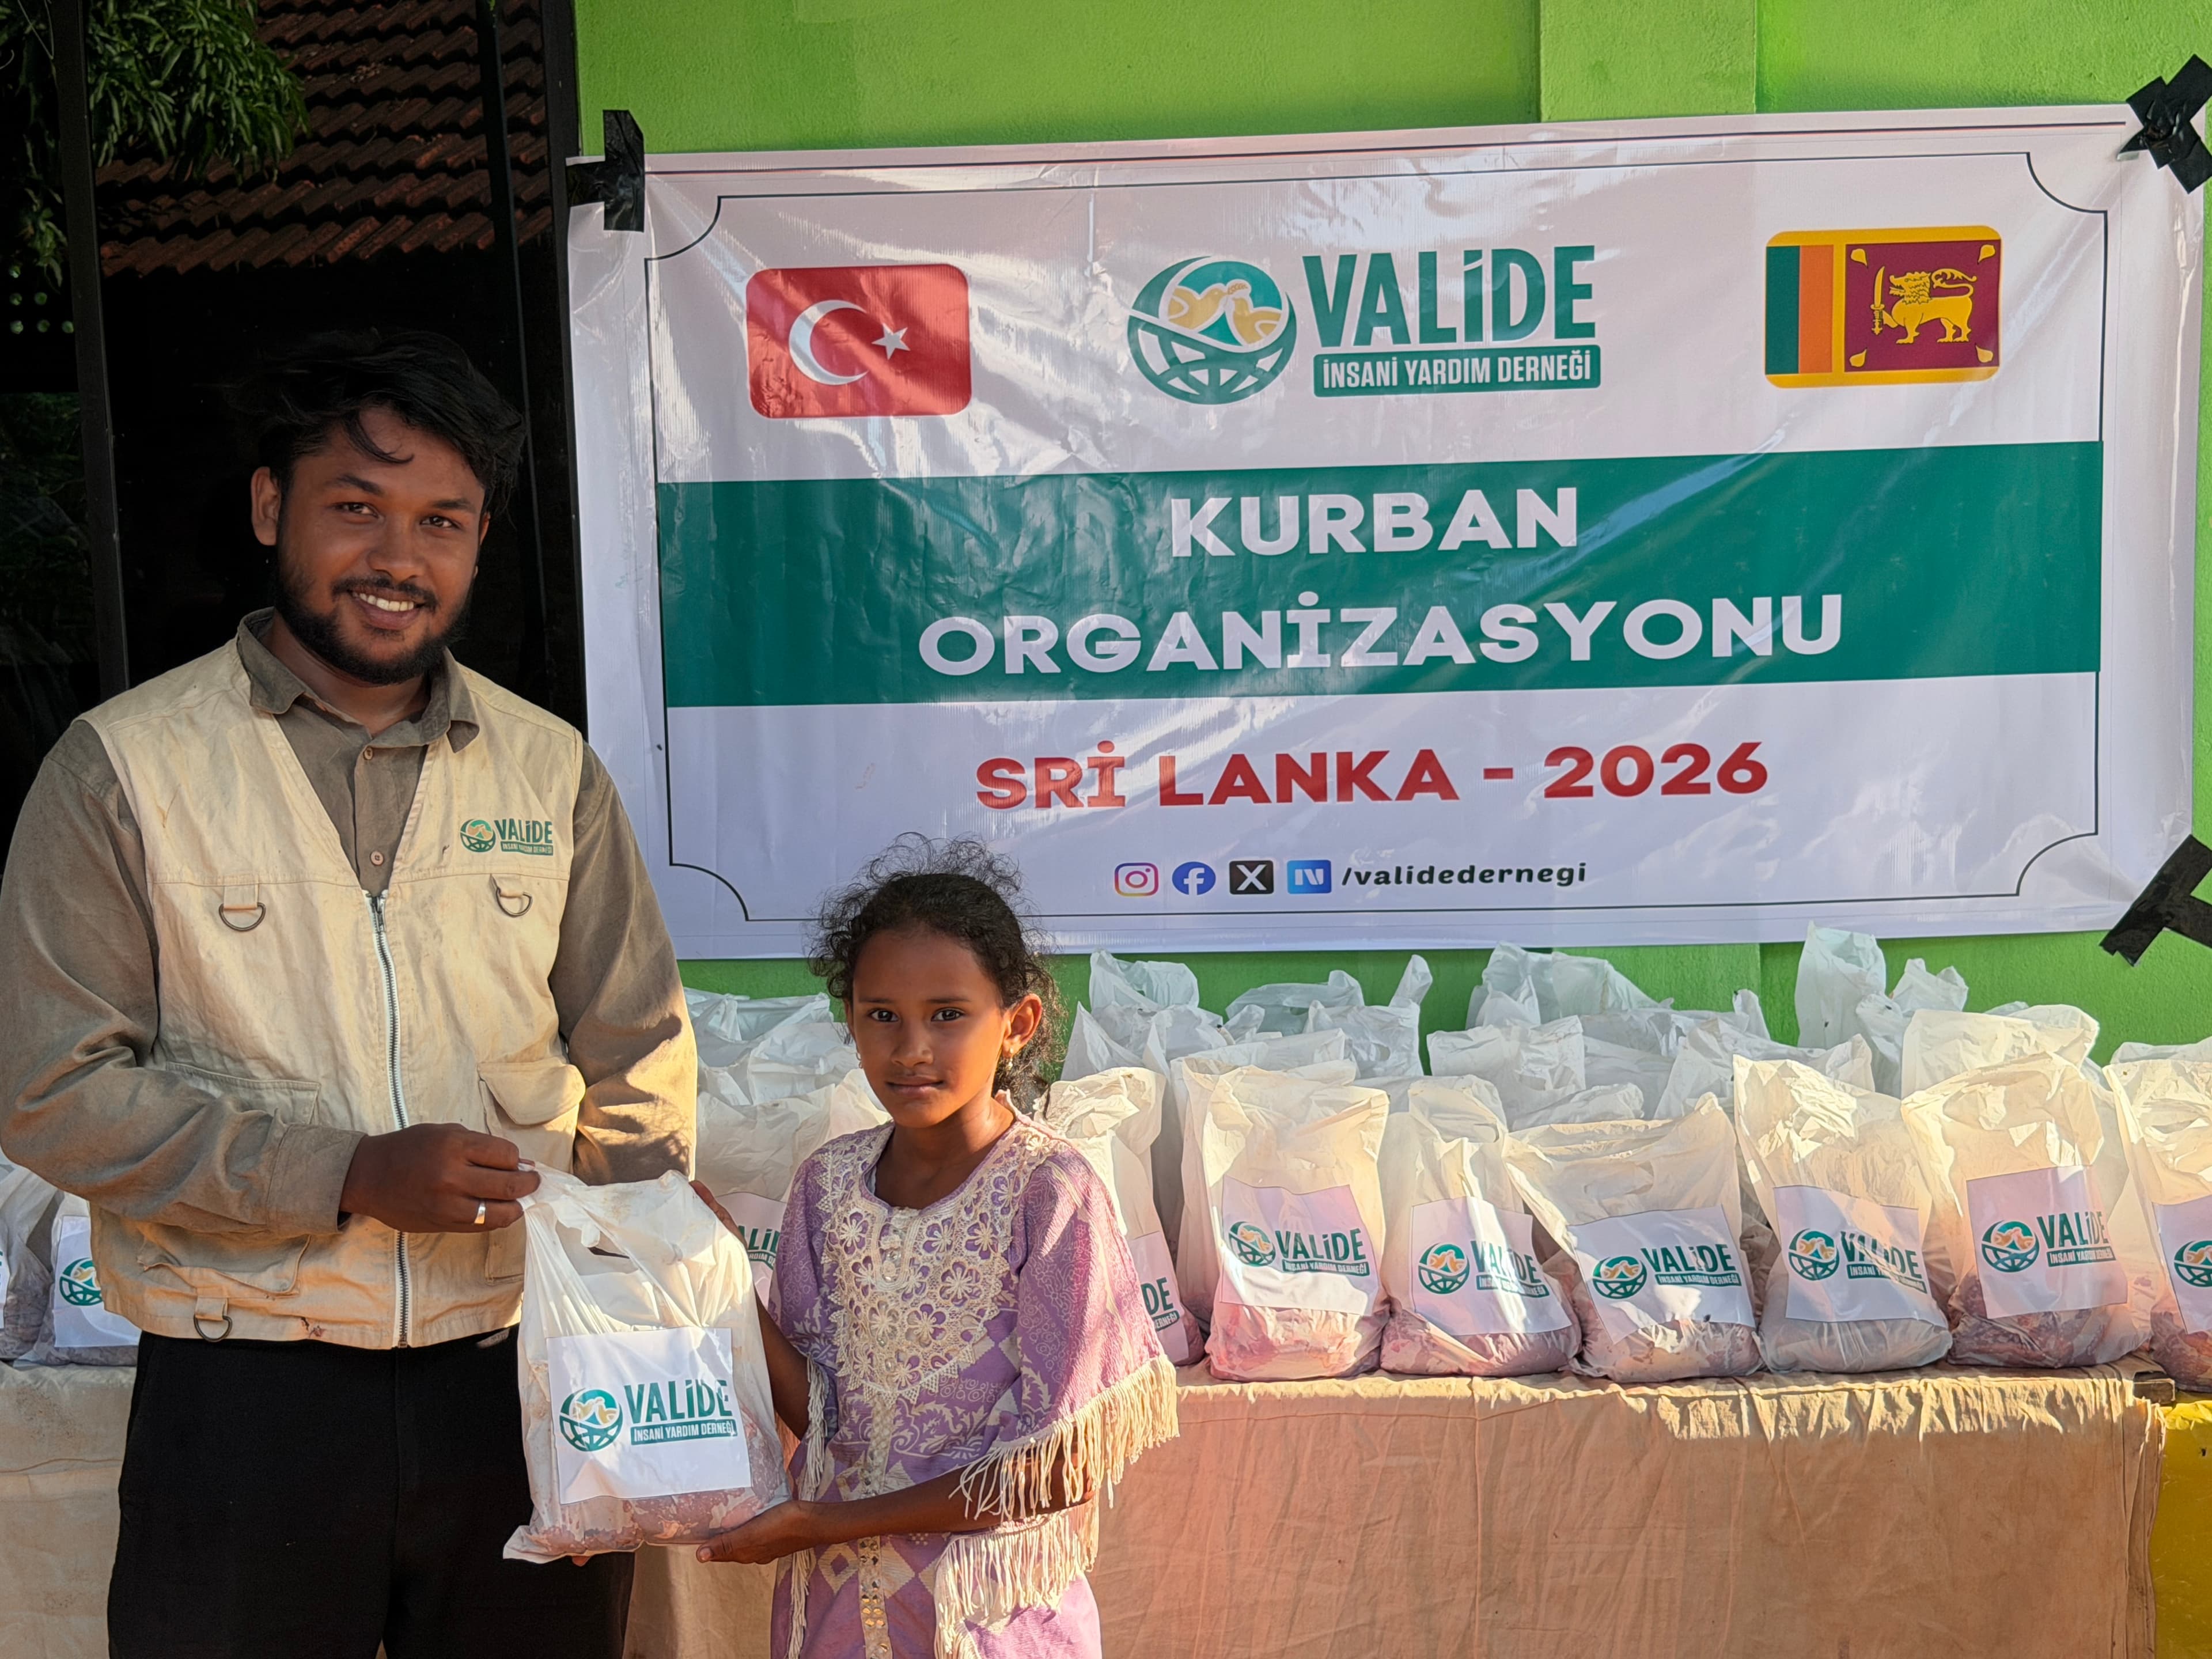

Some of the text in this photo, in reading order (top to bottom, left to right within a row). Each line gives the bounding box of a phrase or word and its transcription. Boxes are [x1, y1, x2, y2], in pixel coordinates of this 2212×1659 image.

[1323, 350, 1591, 389] İNSANİ YARDIM DERNEĞİ
[1172, 488, 1577, 558] KURBAN
[918, 591, 1842, 676] ORGANİZASYONU
[975, 741, 1126, 810] SRİ
[1159, 749, 1460, 806] LANKA
[1543, 741, 1768, 798] 2026
[1342, 862, 1586, 887] /validedernegi
[634, 1426, 664, 1442] İNSANİ
[665, 1425, 699, 1438] YARDIM
